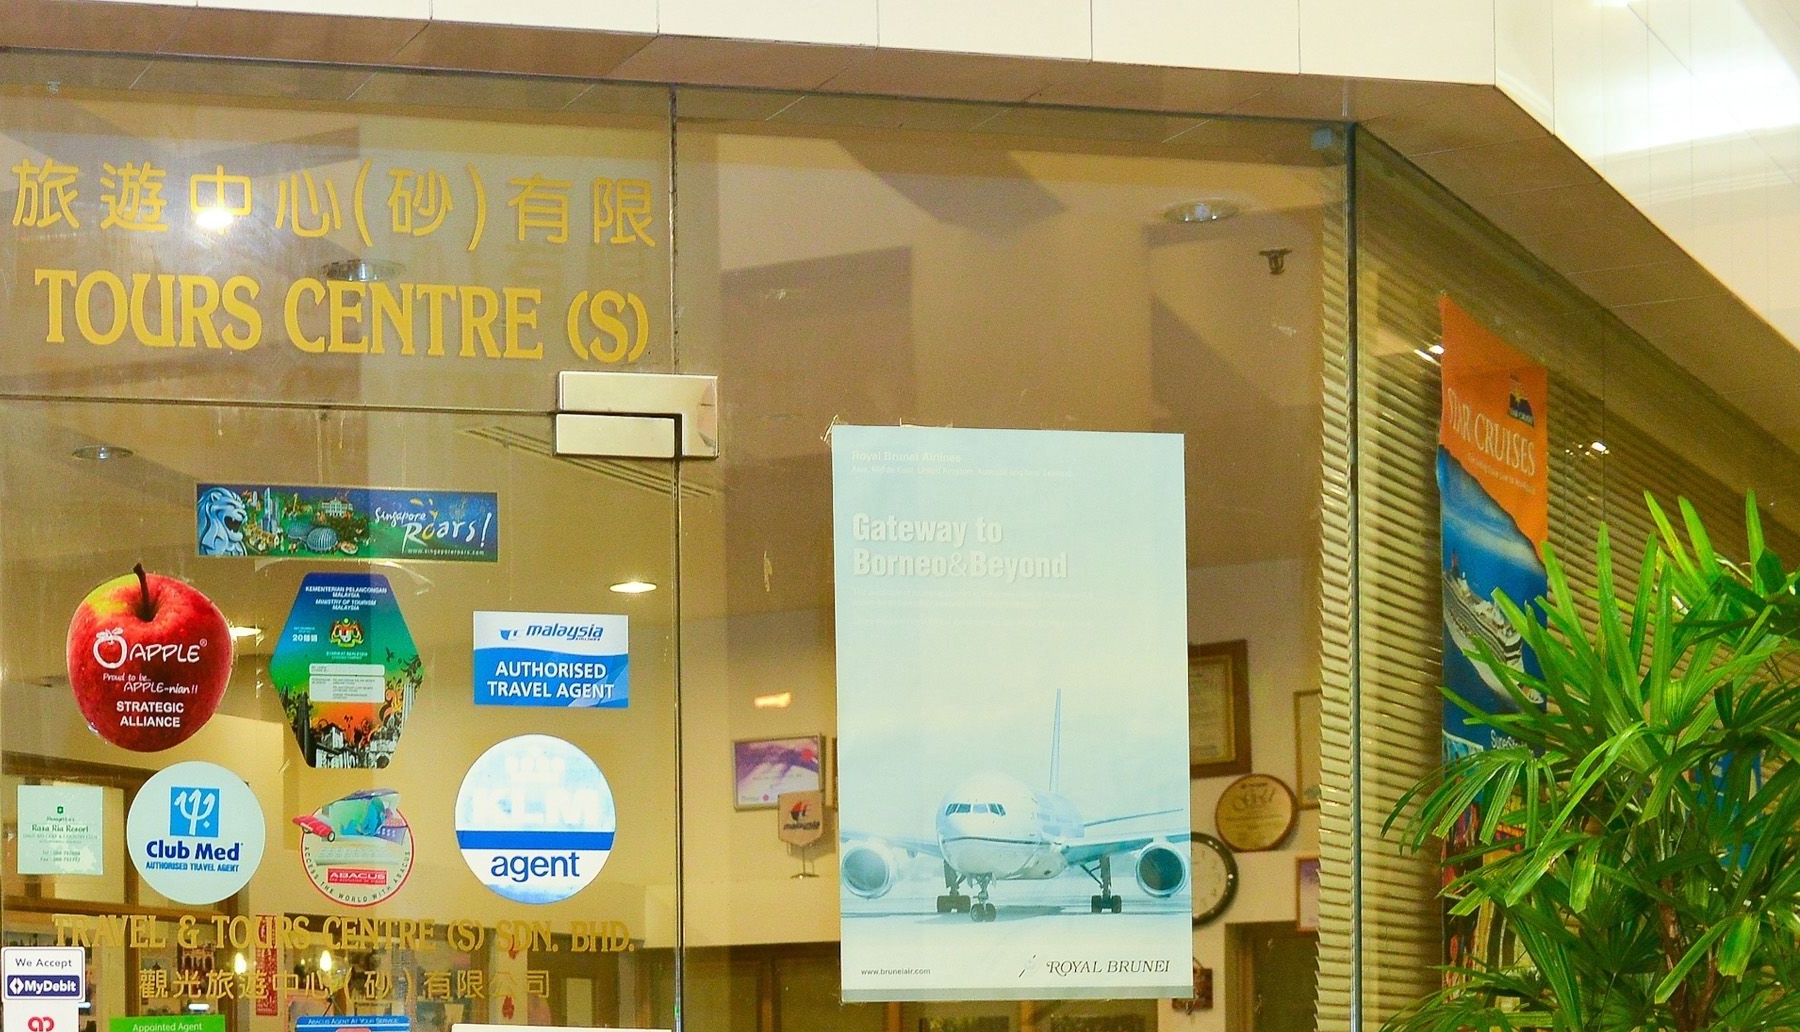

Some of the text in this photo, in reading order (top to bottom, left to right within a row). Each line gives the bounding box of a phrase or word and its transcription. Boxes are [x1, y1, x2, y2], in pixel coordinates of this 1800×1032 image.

[35, 268, 262, 350] TOURS
[284, 276, 543, 361] CENTRE
[567, 290, 650, 365] (S)
[375, 507, 427, 527] Singapore
[401, 512, 492, 553] Roars!
[852, 512, 1003, 548] Gateway to
[525, 623, 604, 641] malaysia
[495, 661, 607, 679] AUTHORISED
[487, 681, 614, 701] TRAVEL AGENT
[116, 701, 184, 713] STRATEGIC
[120, 716, 180, 727] ALLIANCE
[32, 824, 49, 832] Rasa
[145, 840, 239, 861] Club Med
[491, 852, 580, 883] agent
[15, 957, 72, 969] We Accept
[1046, 958, 1170, 977] ROYAL BRUNEI
[24, 977, 77, 994] MyDebit
[132, 1022, 203, 1032] Appointed Agent
